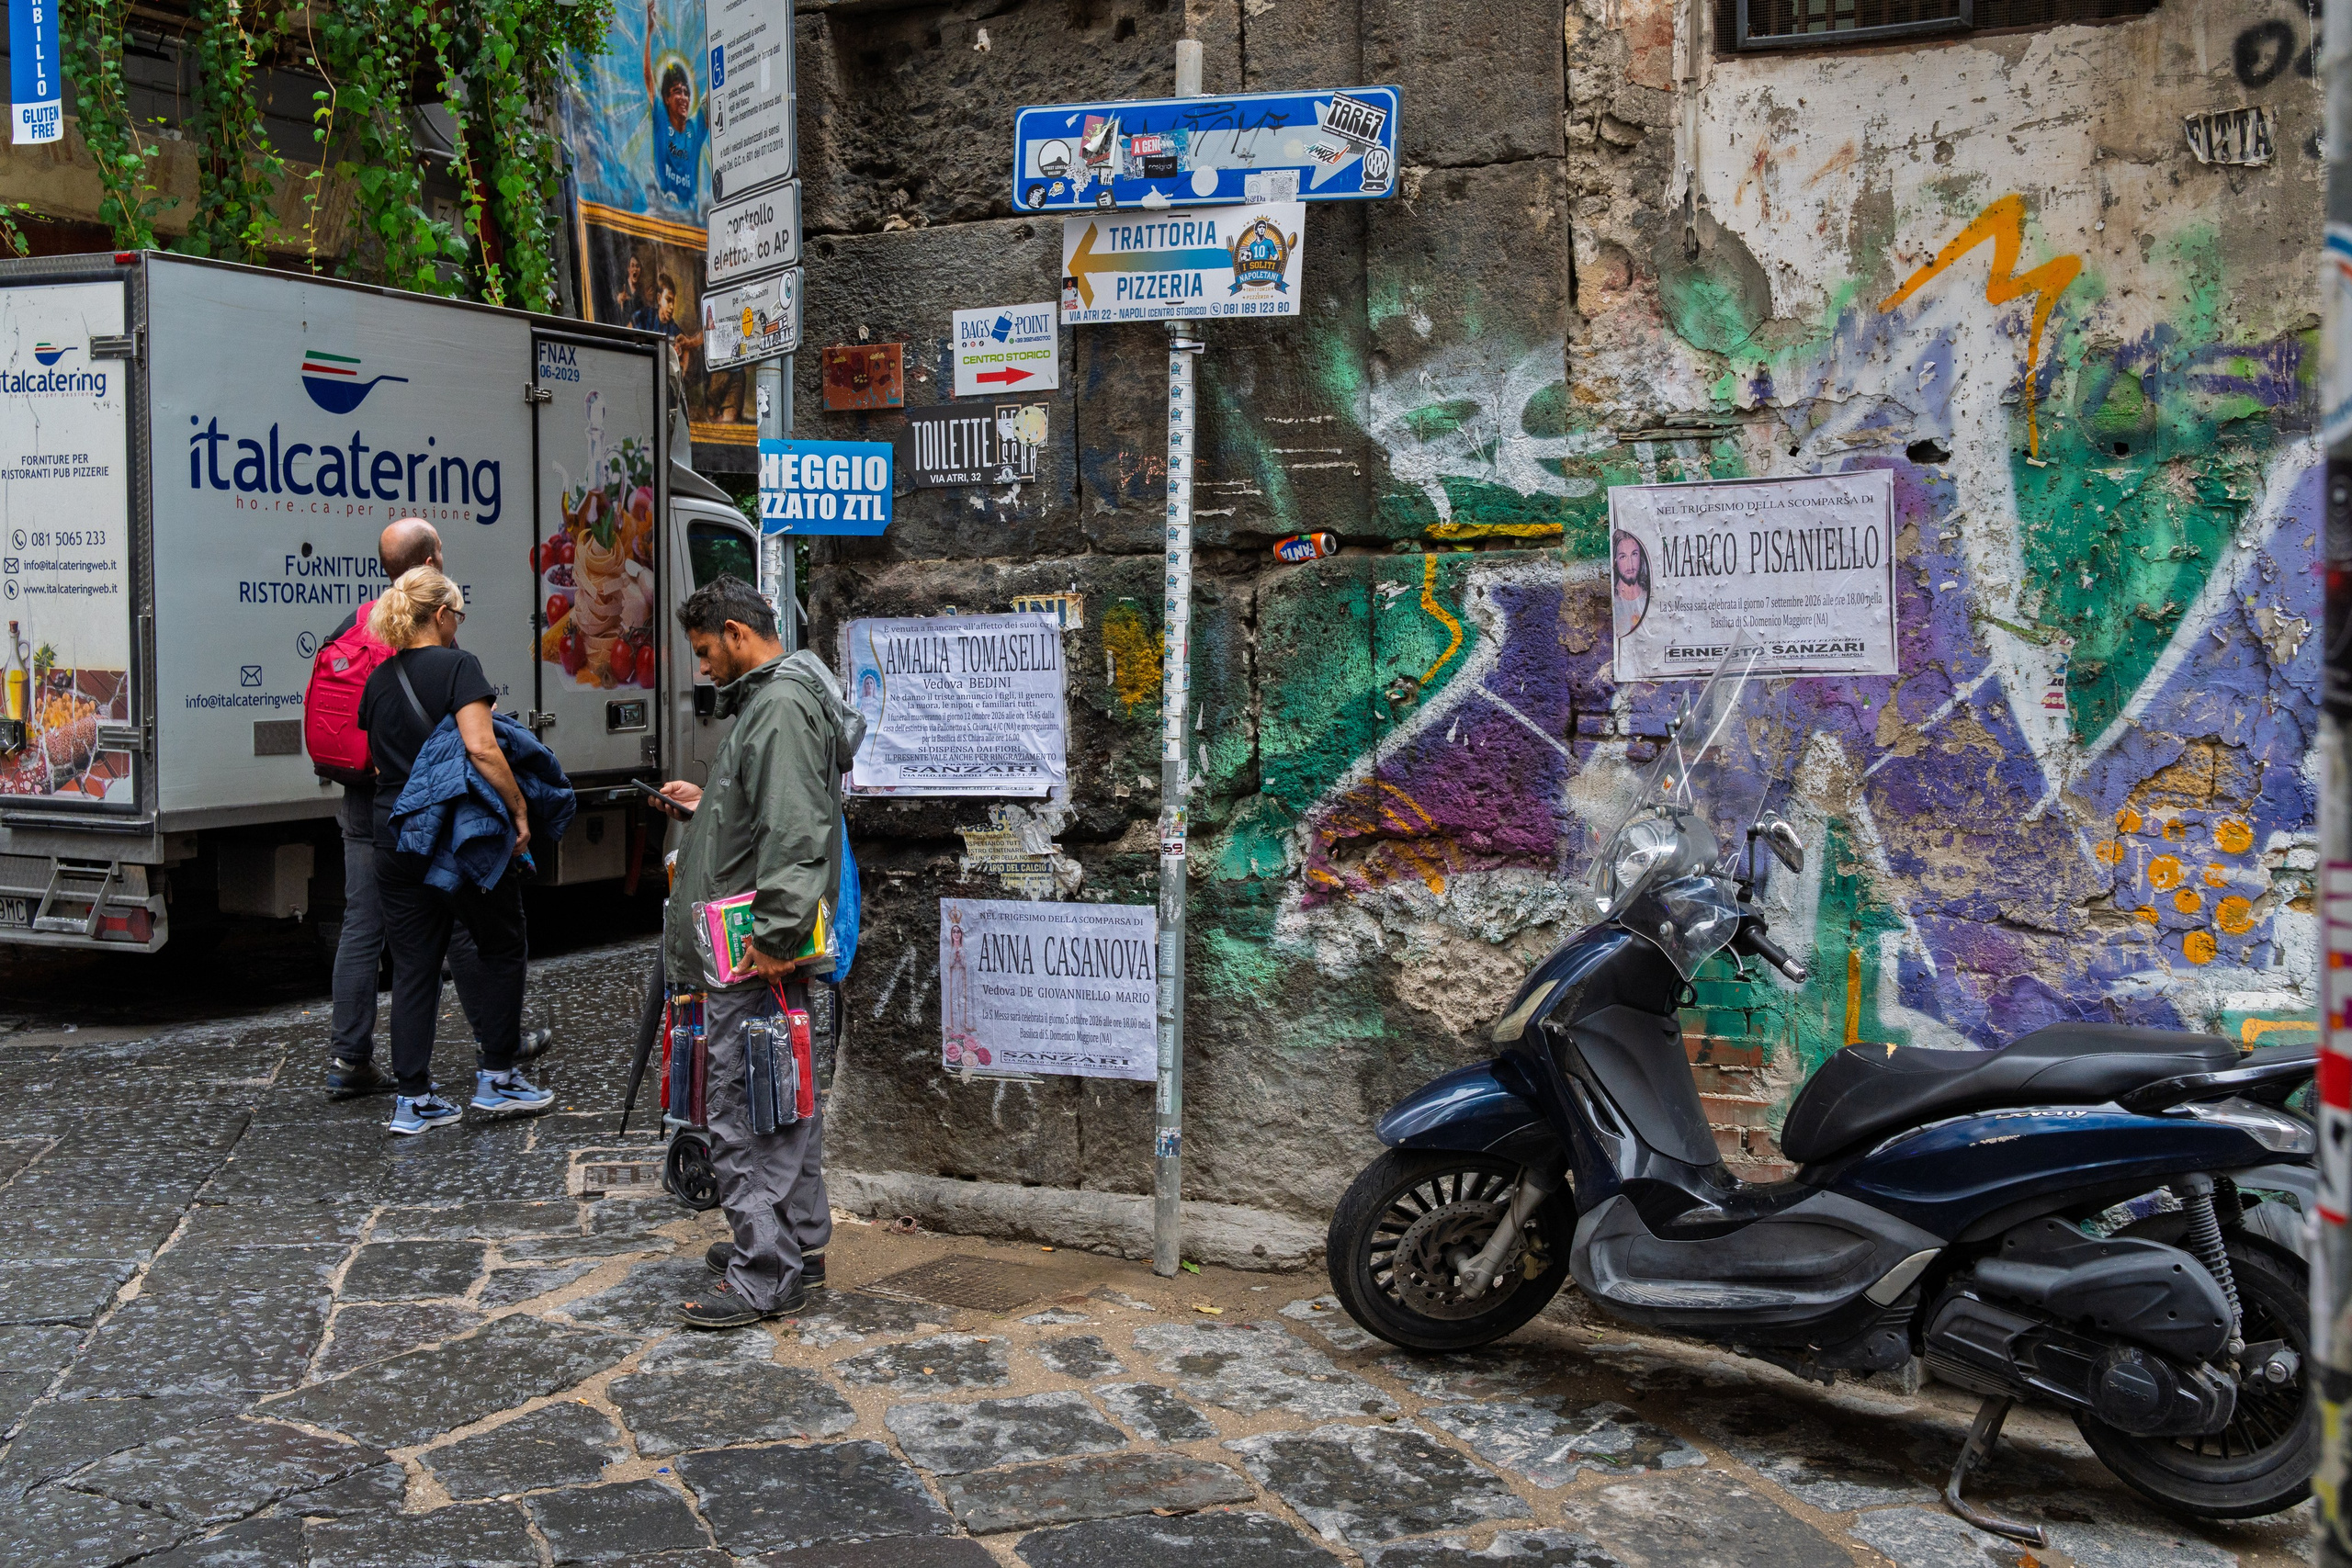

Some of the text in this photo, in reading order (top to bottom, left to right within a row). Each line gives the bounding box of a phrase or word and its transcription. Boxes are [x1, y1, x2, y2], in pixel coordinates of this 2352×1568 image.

[23, 106, 59, 124] GLUTEN
[31, 122, 55, 139] FREE
[768, 122, 778, 137] sensi
[1134, 141, 1140, 154] A
[665, 164, 691, 187] Napoli
[726, 202, 774, 234] controllo
[1109, 220, 1216, 251] TRATTORIA
[714, 229, 789, 271] elettroco AP
[1253, 244, 1266, 258] 10
[1250, 261, 1276, 270] SOLITI
[1238, 271, 1279, 282] NAPOLETANI
[1116, 273, 1204, 300] PIZZERIA
[1069, 301, 1290, 321] VIA ATRI 22 NAPOLI (CENTRO STORICO) 081 189 123 80
[961, 314, 1049, 339] BAGS POINT
[538, 342, 577, 367] FNAX
[963, 350, 1050, 365] CENTRO STORICO
[539, 364, 580, 382] 06-2029
[912, 417, 992, 470] TOILETTE
[21, 453, 89, 466] FORNITURE PER
[1, 466, 109, 479] RISTORANTI PUB PIZZERIE
[190, 416, 502, 525] italcatering
[930, 472, 982, 483] VIA ATRI, 32
[389, 505, 470, 521] passione
[842, 494, 886, 521] ZTL
[1657, 495, 1873, 515] NEL TRIGESIMO DELLA SCOMPARSA DI
[31, 530, 106, 547] 081 5065 233
[1280, 542, 1317, 562] FANTA
[1662, 525, 1879, 578] MARCO PISANIELLO
[23, 558, 118, 571] info@italcateringweb.it
[23, 581, 119, 595] www.italcateringweb.it
[239, 581, 351, 604] RISTORANTI
[1694, 592, 1865, 612] sarà celebrata giorno settembre 2026 alle 18,00
[884, 625, 889, 633] È
[964, 622, 1002, 630] all'affetto
[1711, 613, 1828, 628] Basilica di S. Domenico Maggiore (NA)
[886, 634, 1057, 674] AMALIA TOMASELLI
[1668, 643, 1865, 658] ERNESTO SANZARI
[922, 677, 1011, 689] Vedova BEDINI
[999, 692, 1016, 701] figli,
[990, 752, 1057, 761] RINGRAZIAMENTO
[1006, 863, 1046, 872] DEL CALCIO
[979, 912, 997, 920] NEL
[999, 912, 1046, 922] TRIGESIMO
[1048, 915, 1078, 923] DELLA
[1079, 916, 1131, 926] SCOMPARSA
[978, 933, 1035, 974] ANNA
[1045, 936, 1151, 980] CASANOVA
[982, 985, 1150, 1003] Vedova DE GIOVANNIELLO MARIO
[1003, 1052, 1129, 1066] SANZARI
